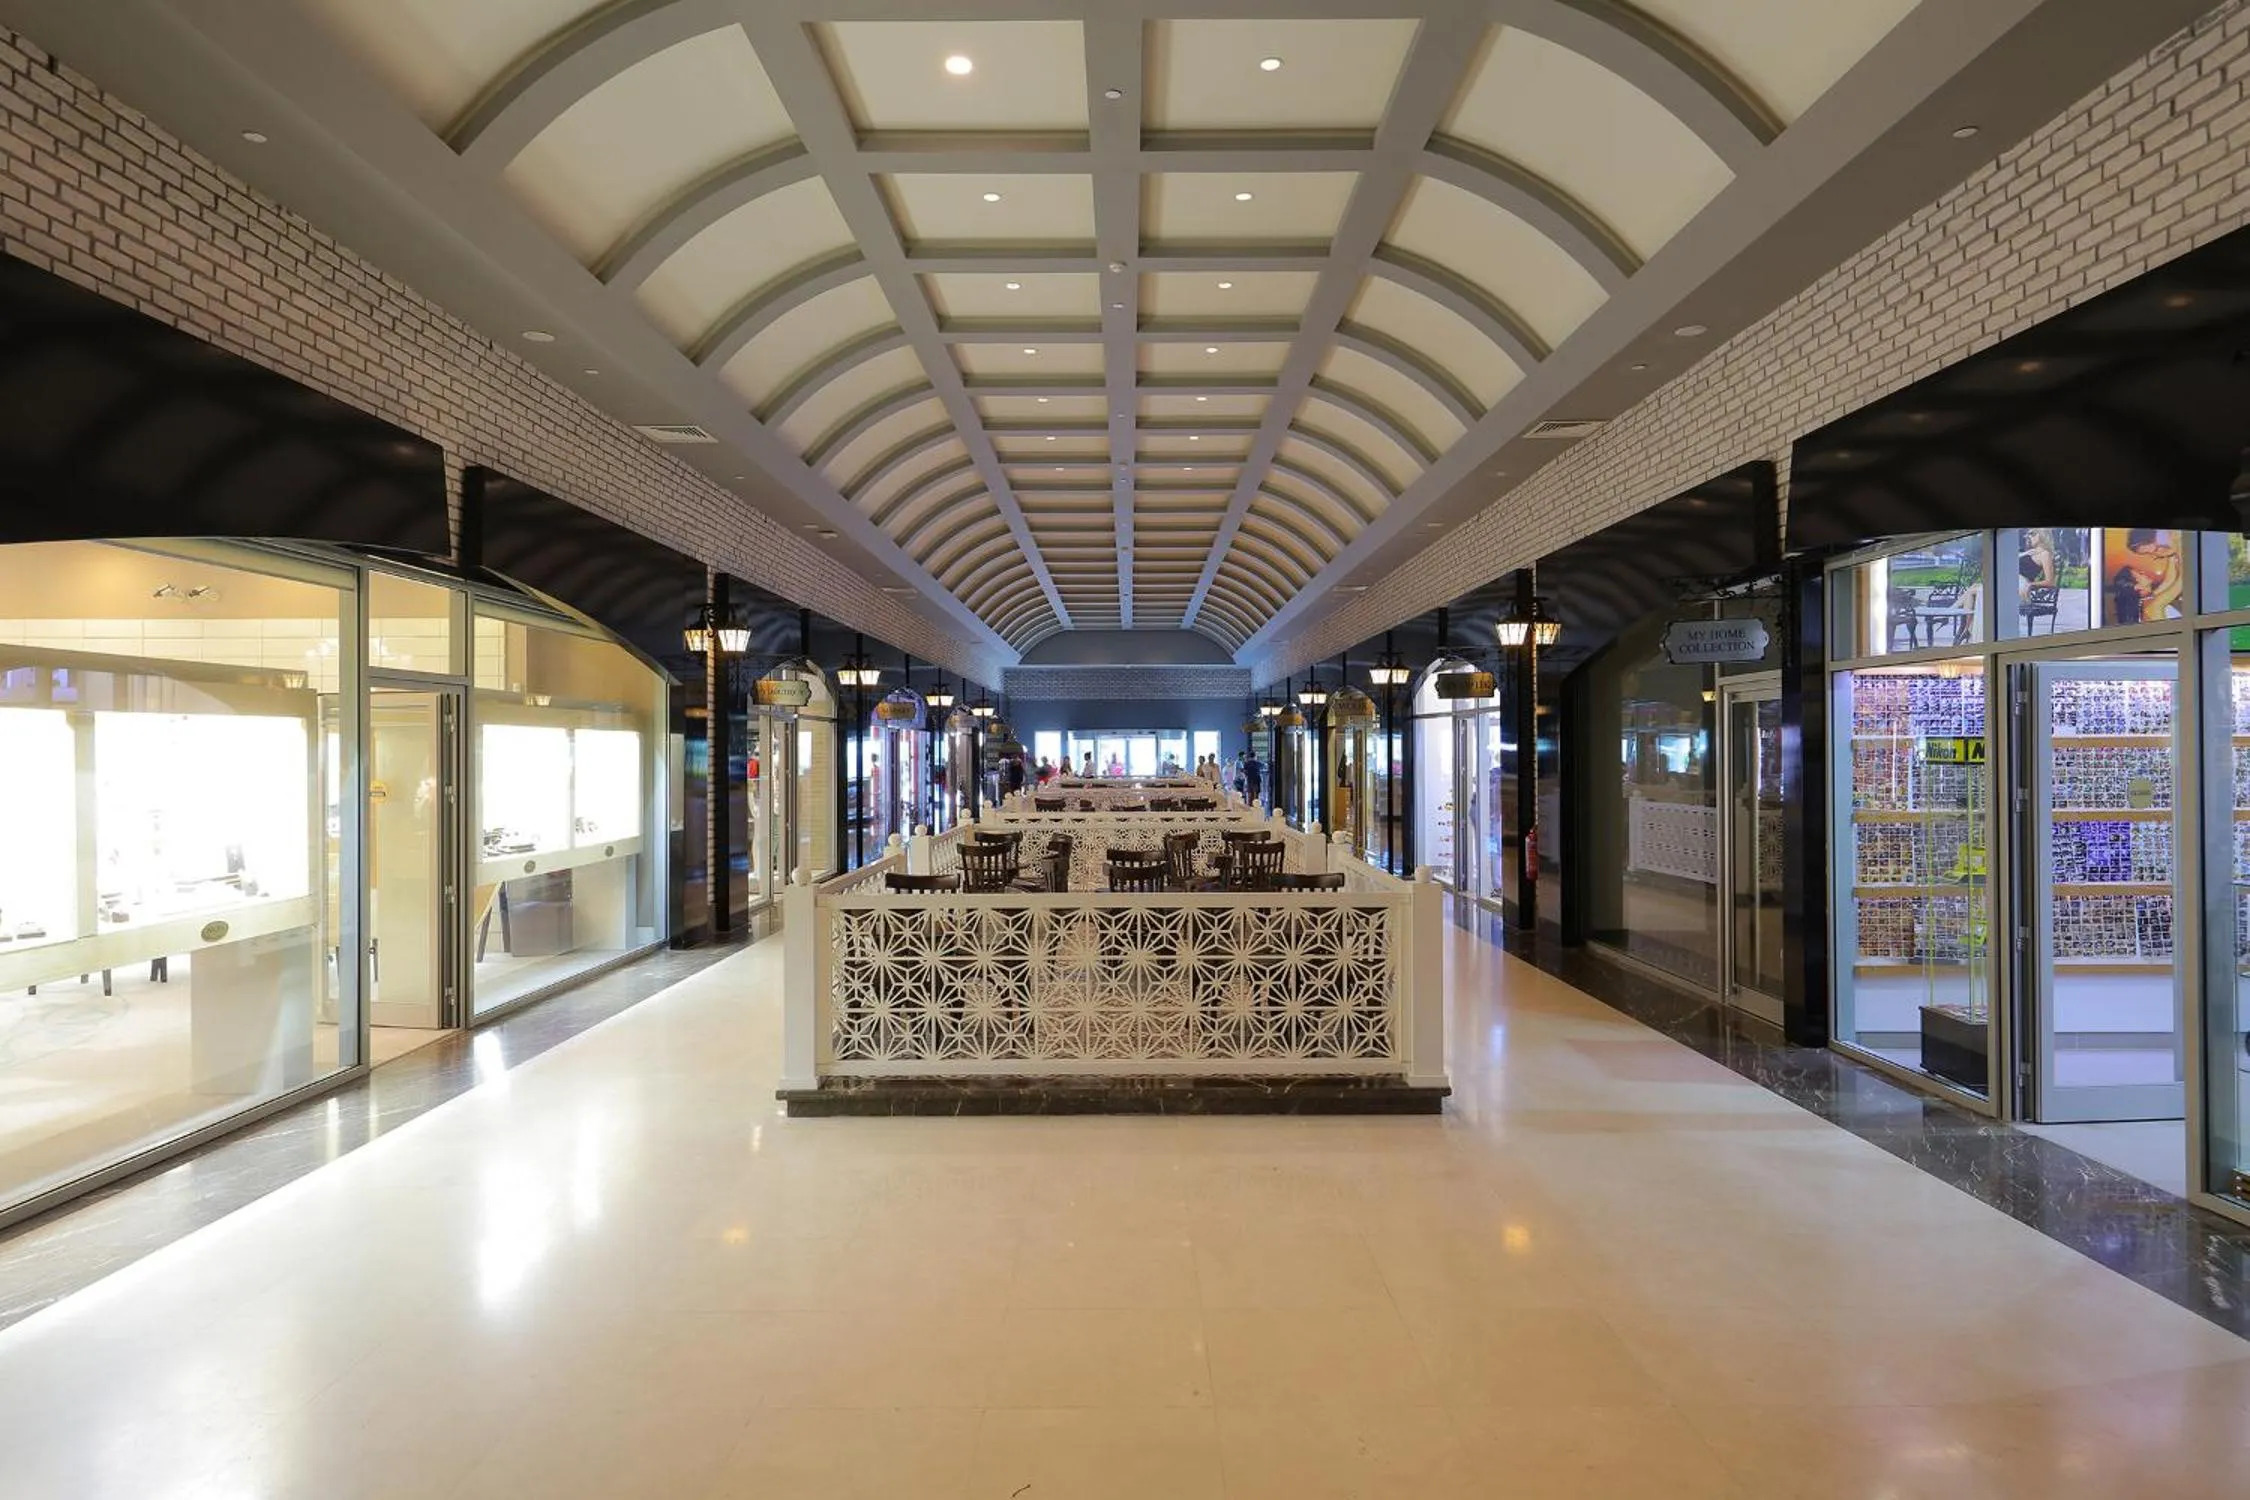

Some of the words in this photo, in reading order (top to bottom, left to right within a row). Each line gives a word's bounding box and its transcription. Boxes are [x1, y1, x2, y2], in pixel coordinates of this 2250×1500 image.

[1688, 630, 1706, 640] MY
[1710, 628, 1746, 639] HOME
[1679, 640, 1755, 654] COLLECTION
[1926, 742, 1957, 759] Nikon
